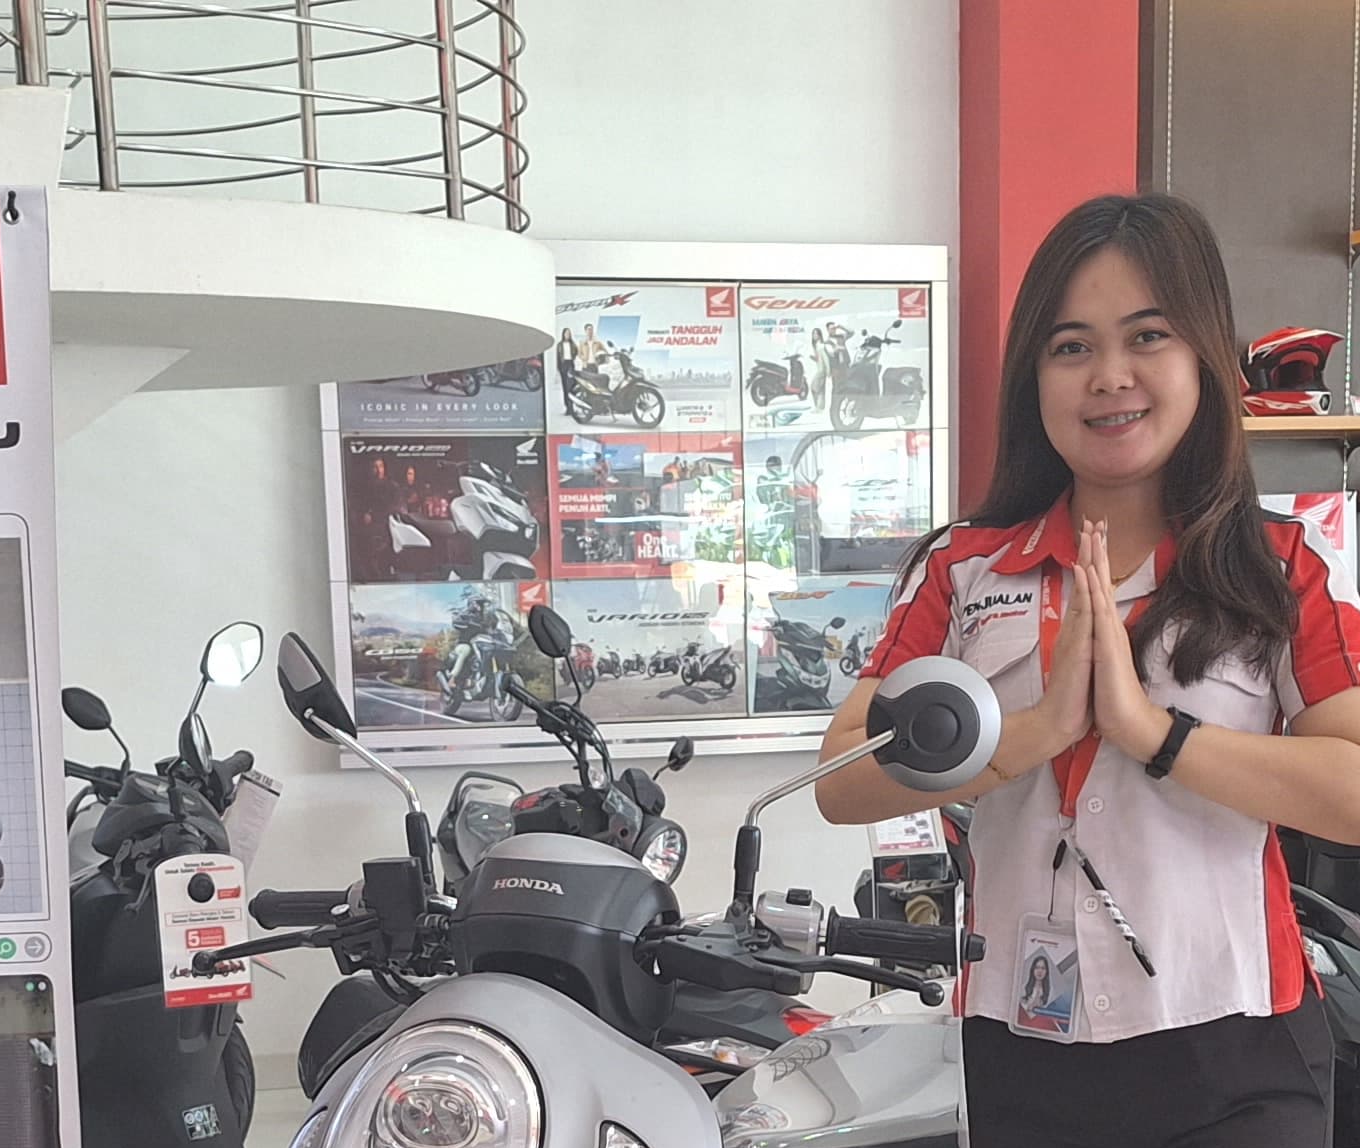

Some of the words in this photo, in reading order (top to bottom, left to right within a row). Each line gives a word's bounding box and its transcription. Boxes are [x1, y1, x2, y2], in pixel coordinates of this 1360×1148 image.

[744, 296, 840, 310] Genio
[671, 325, 723, 335] TANGGUH
[664, 336, 718, 346] ANDALAN
[360, 403, 407, 412] ICONIC
[415, 403, 429, 412] IN
[436, 403, 477, 412] EVERY
[485, 403, 518, 411] LOOK
[964, 592, 1033, 616] PENJUALAN
[493, 878, 565, 895] HONDA
[187, 930, 201, 947] 5
